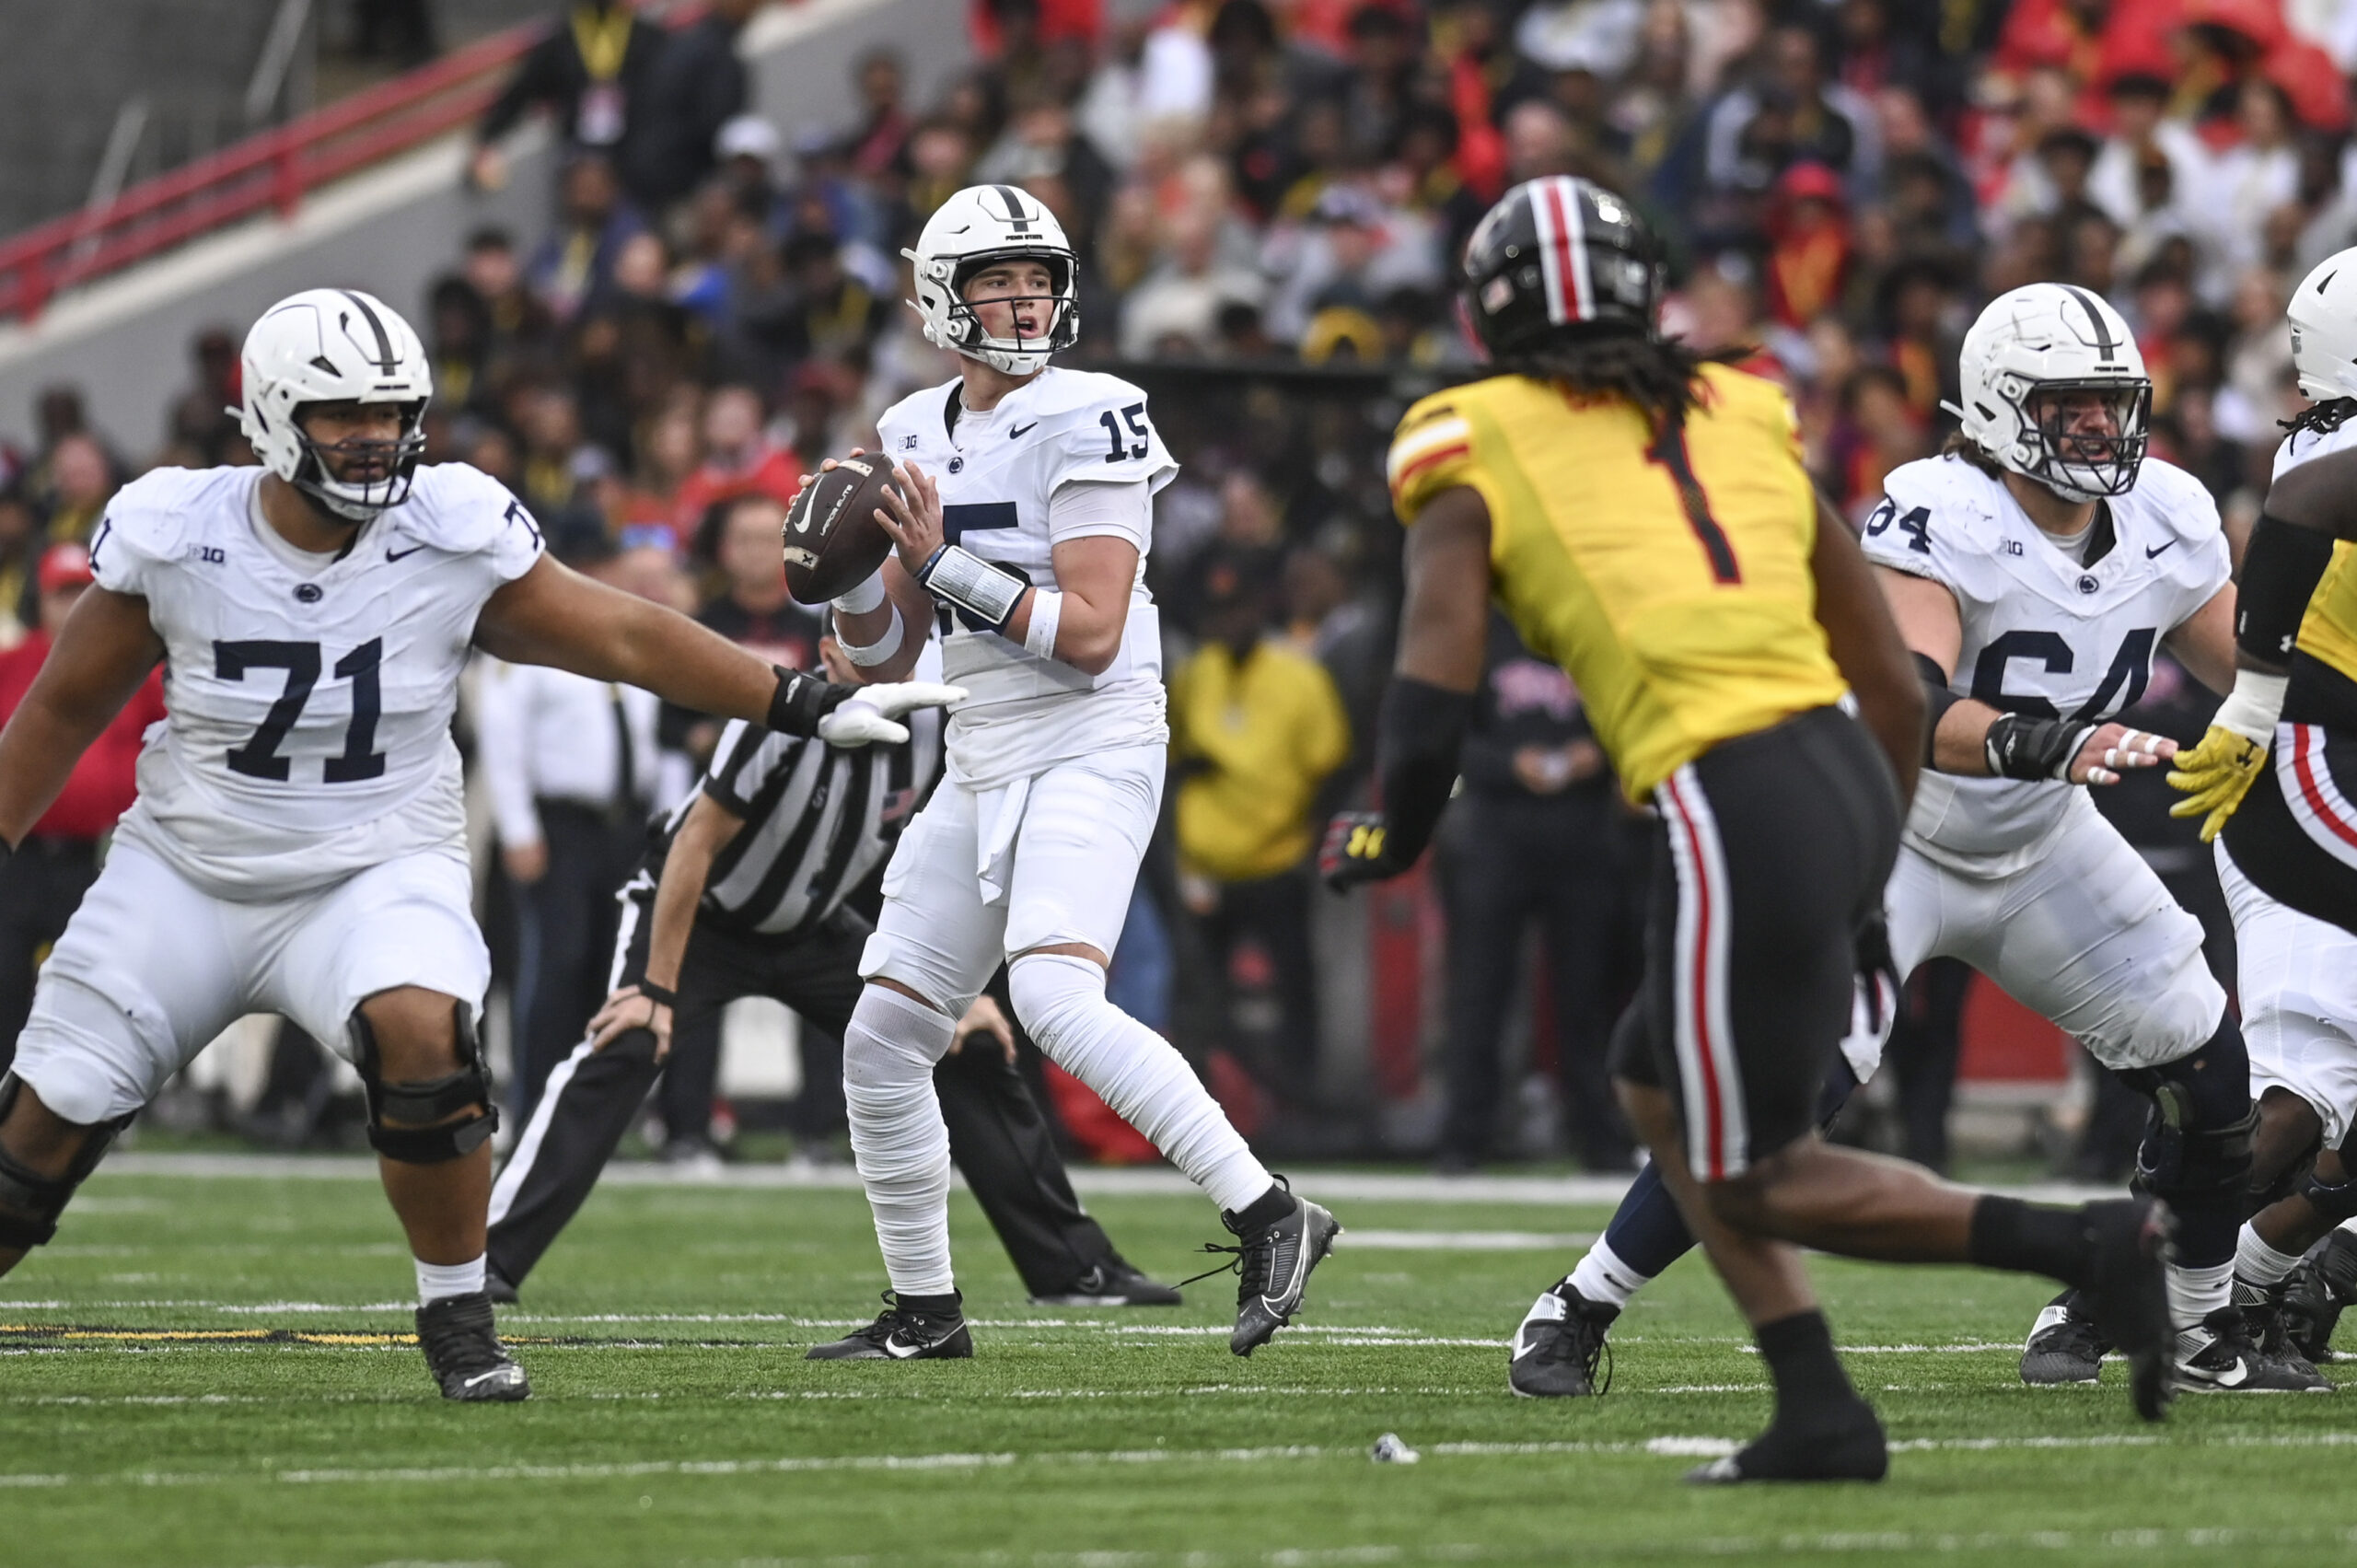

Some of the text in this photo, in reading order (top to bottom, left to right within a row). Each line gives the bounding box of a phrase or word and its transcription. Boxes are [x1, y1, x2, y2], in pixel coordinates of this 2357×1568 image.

[1099, 401, 1148, 464] 15
[1643, 405, 1743, 585] 1
[212, 636, 387, 784] 71
[1970, 627, 2157, 724] 64
